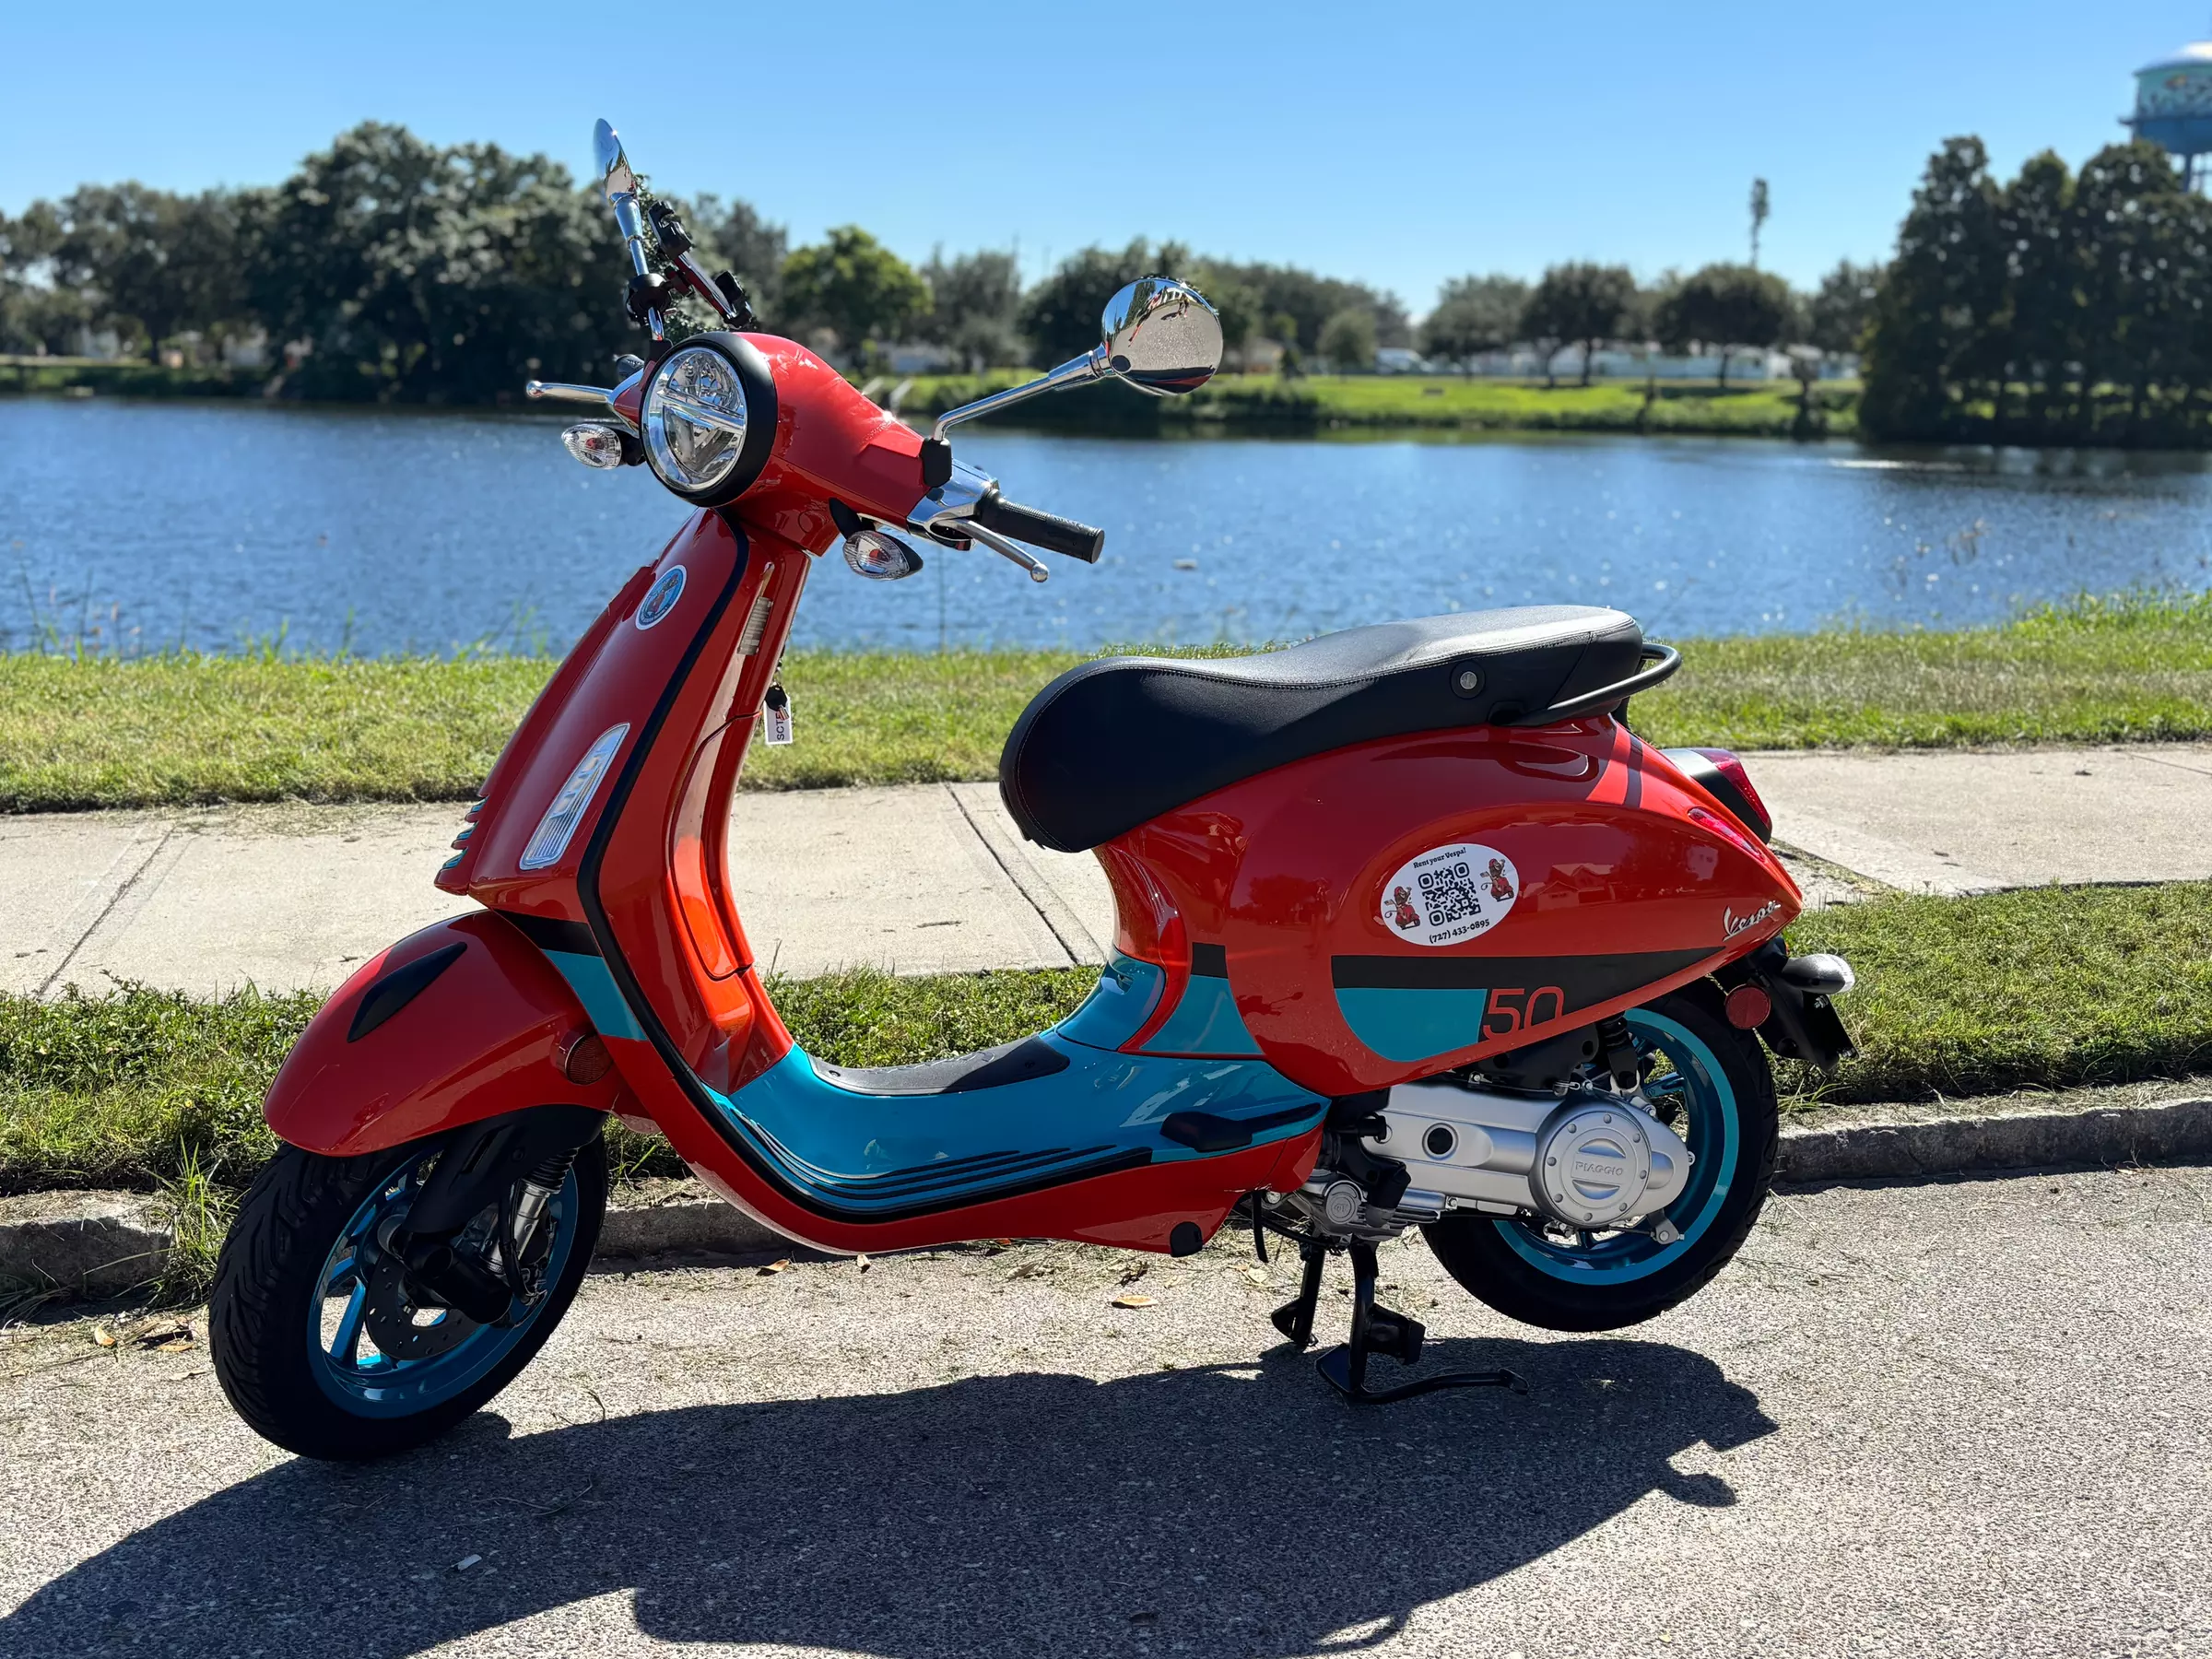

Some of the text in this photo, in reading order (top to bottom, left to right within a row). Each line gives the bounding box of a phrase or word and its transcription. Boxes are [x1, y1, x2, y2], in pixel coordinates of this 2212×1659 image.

[1413, 847, 1466, 869] Rent your Vespa!
[1429, 919, 1490, 944] (727) 433-0895
[1722, 900, 1782, 943] Vespa
[1483, 986, 1564, 1041] 50
[1574, 1160, 1624, 1177] PIAGGIO
